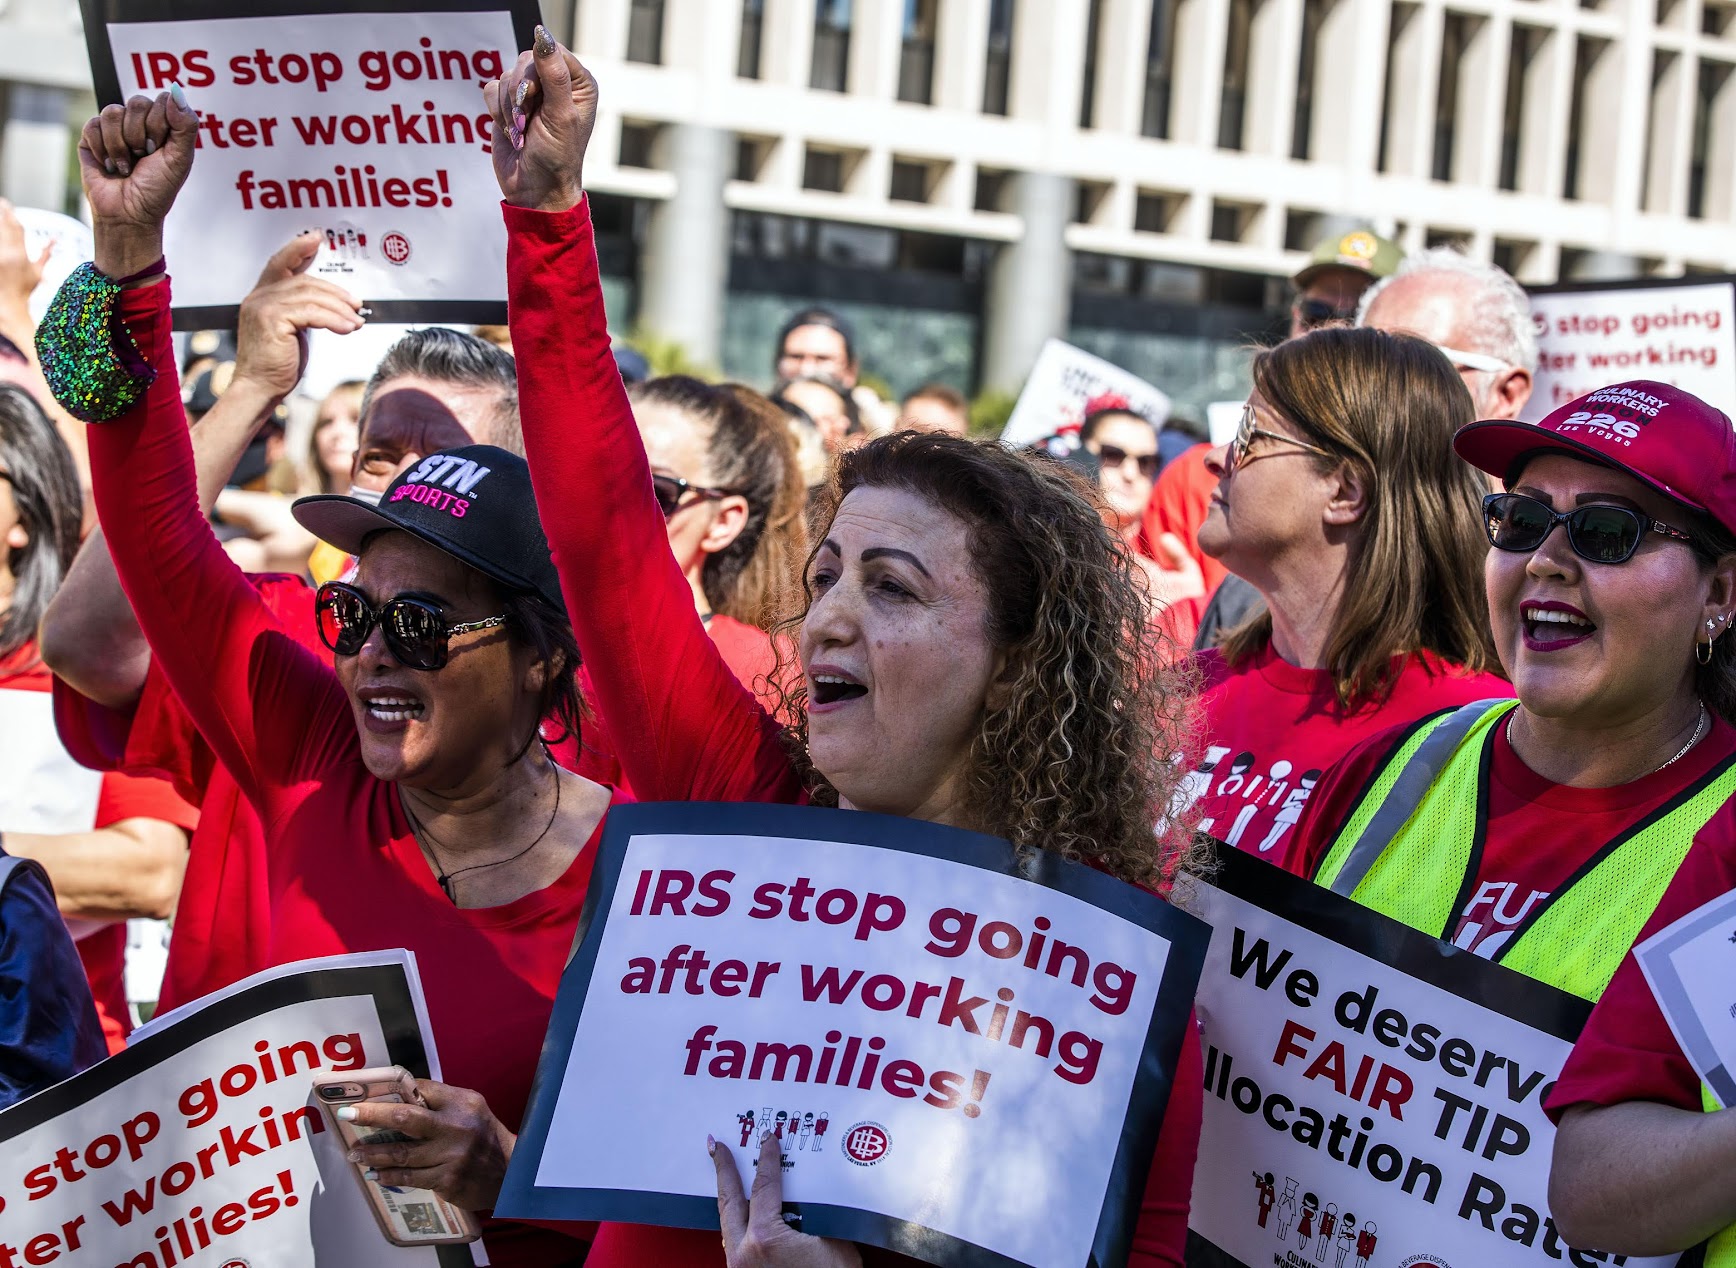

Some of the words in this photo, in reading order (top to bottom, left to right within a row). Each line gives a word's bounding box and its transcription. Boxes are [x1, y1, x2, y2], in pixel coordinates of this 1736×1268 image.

[130, 49, 216, 89] IRS
[228, 48, 343, 92] stop
[358, 37, 504, 91] going
[236, 165, 453, 210] families!
[1557, 314, 1620, 335] stop
[1631, 306, 1721, 335] going
[1588, 343, 1718, 368] working
[1578, 402, 1653, 426] UNION
[1586, 394, 1660, 417] WORKERS
[1594, 387, 1670, 409] CULINARY
[1562, 411, 1641, 438] 226
[1588, 426, 1632, 447] Vegas
[406, 454, 491, 495] STN
[389, 483, 471, 518] SPORTS
[1461, 880, 1551, 925] FU
[629, 869, 737, 917] IRS
[748, 877, 907, 941] stop
[923, 906, 1138, 1016] going
[620, 944, 781, 998] after
[799, 963, 1105, 1085] working
[1228, 926, 1320, 1008] We
[1334, 984, 1558, 1110] deserv
[683, 1024, 992, 1119] families!
[1272, 1018, 1415, 1122] FAIR
[1432, 1086, 1531, 1162] TIP
[23, 1110, 162, 1201] stop
[177, 1032, 367, 1129] going
[1203, 1044, 1443, 1205] llocation
[100, 1105, 326, 1228] workin
